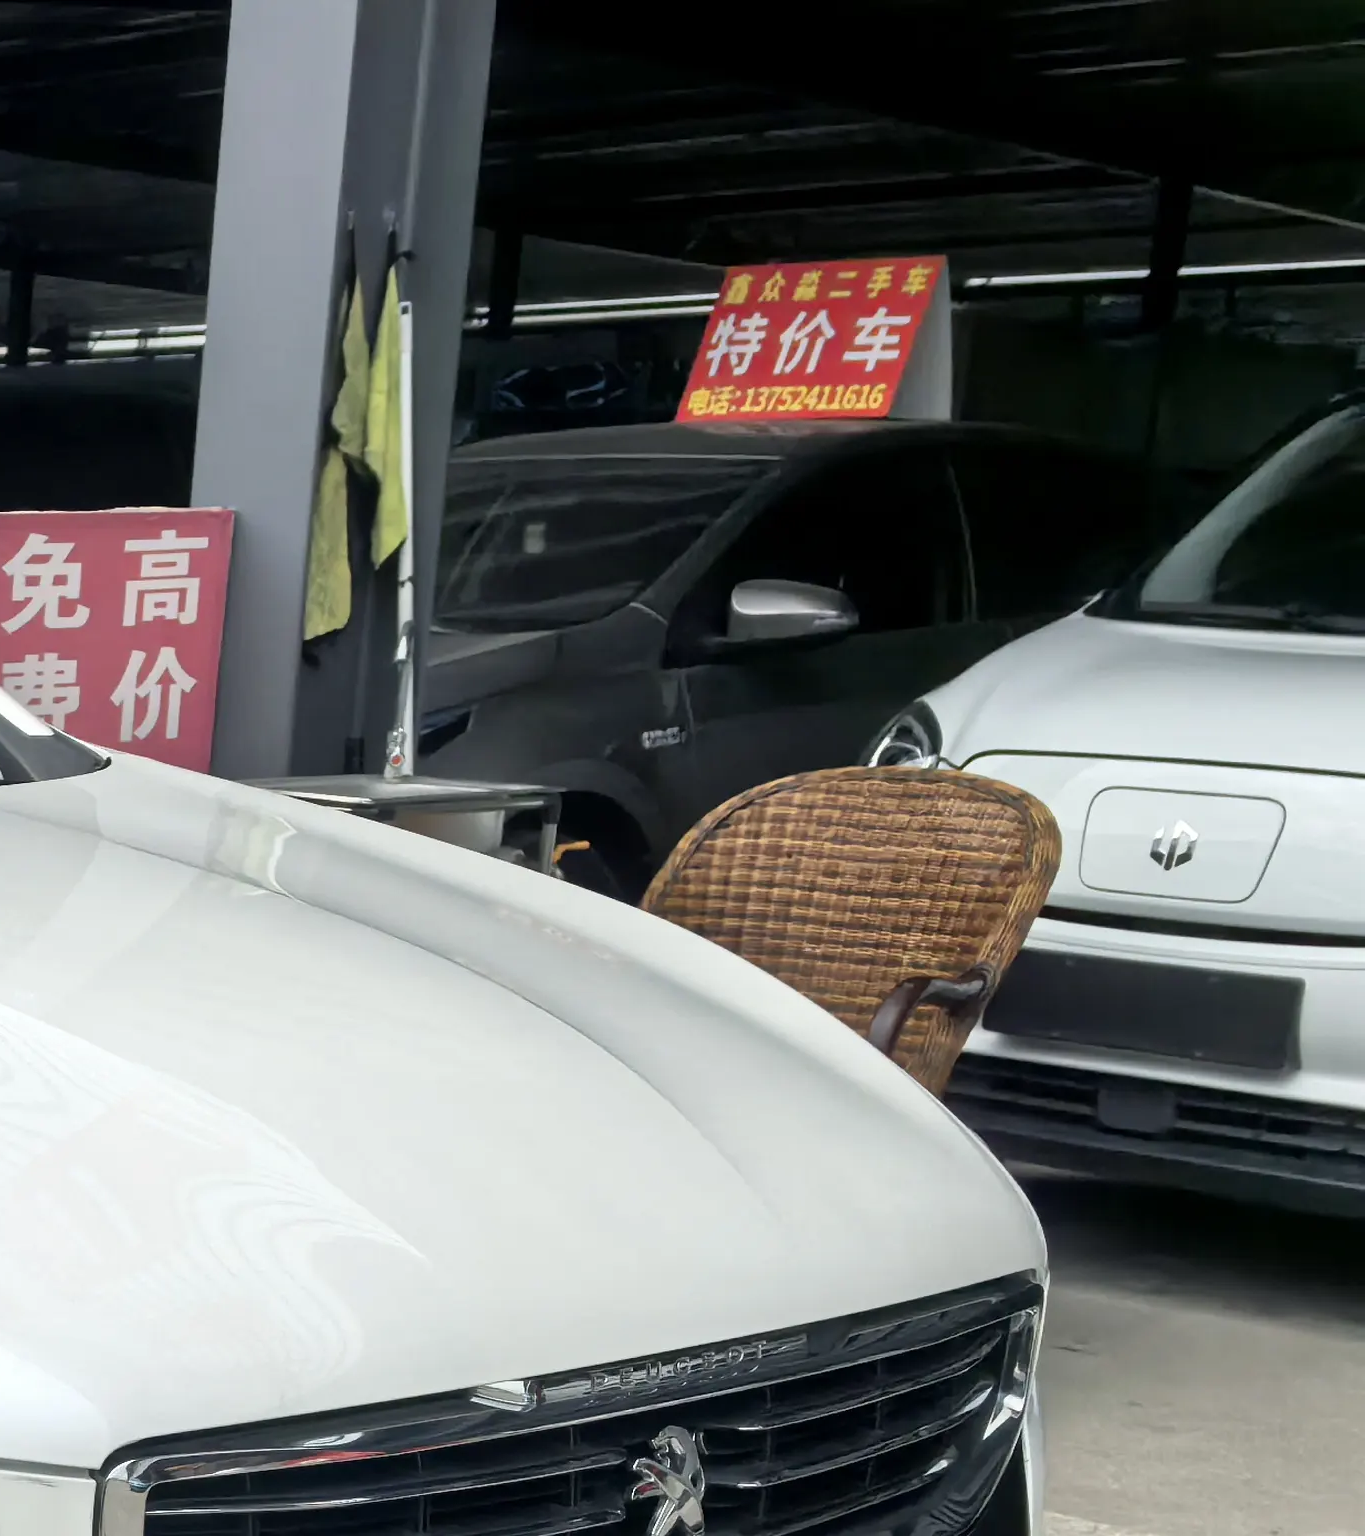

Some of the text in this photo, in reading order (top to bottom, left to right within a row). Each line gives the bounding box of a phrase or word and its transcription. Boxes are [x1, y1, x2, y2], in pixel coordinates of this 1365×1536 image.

[705, 306, 911, 376] 特价车
[0, 532, 91, 732] 免费
[109, 530, 209, 743] 高价
